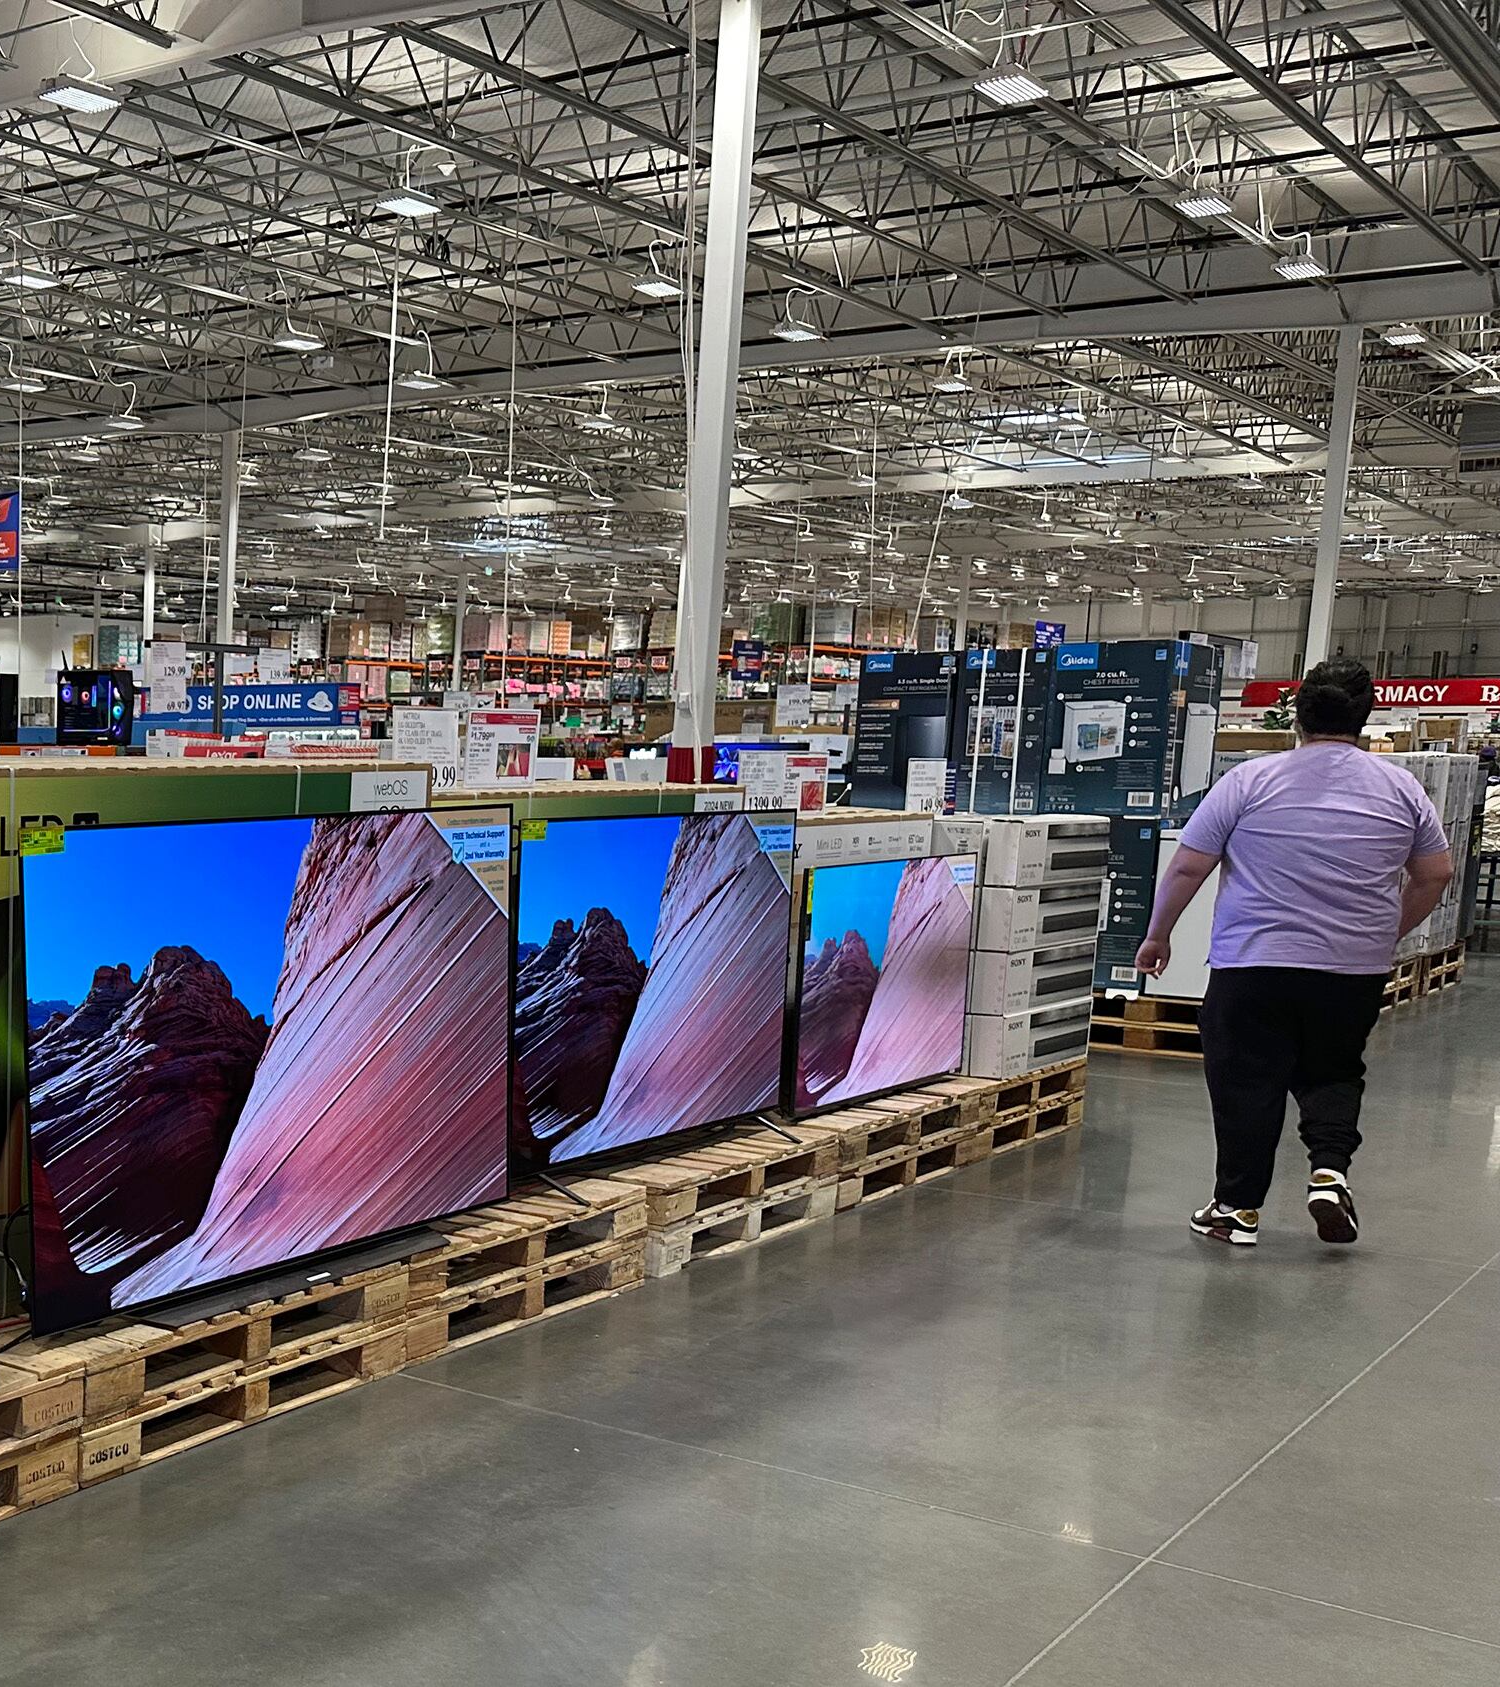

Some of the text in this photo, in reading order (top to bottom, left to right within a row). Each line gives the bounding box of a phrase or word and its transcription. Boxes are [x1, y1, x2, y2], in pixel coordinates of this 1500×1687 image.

[869, 659, 892, 670] Midea
[1060, 653, 1095, 667] Midea
[164, 666, 186, 677] 129.99
[919, 677, 935, 685] Single
[1108, 677, 1140, 686] FREEZER
[1374, 684, 1449, 703] RMACY
[197, 693, 302, 711] SHOP ONLINE
[207, 749, 237, 758] Lexar
[373, 779, 409, 796] webOS
[720, 800, 734, 810] NEW
[452, 830, 505, 841] FREE Technical Support
[34, 1400, 74, 1424] COSTCO
[89, 1443, 130, 1466] COSTCO
[25, 1460, 65, 1485] COSTCO
